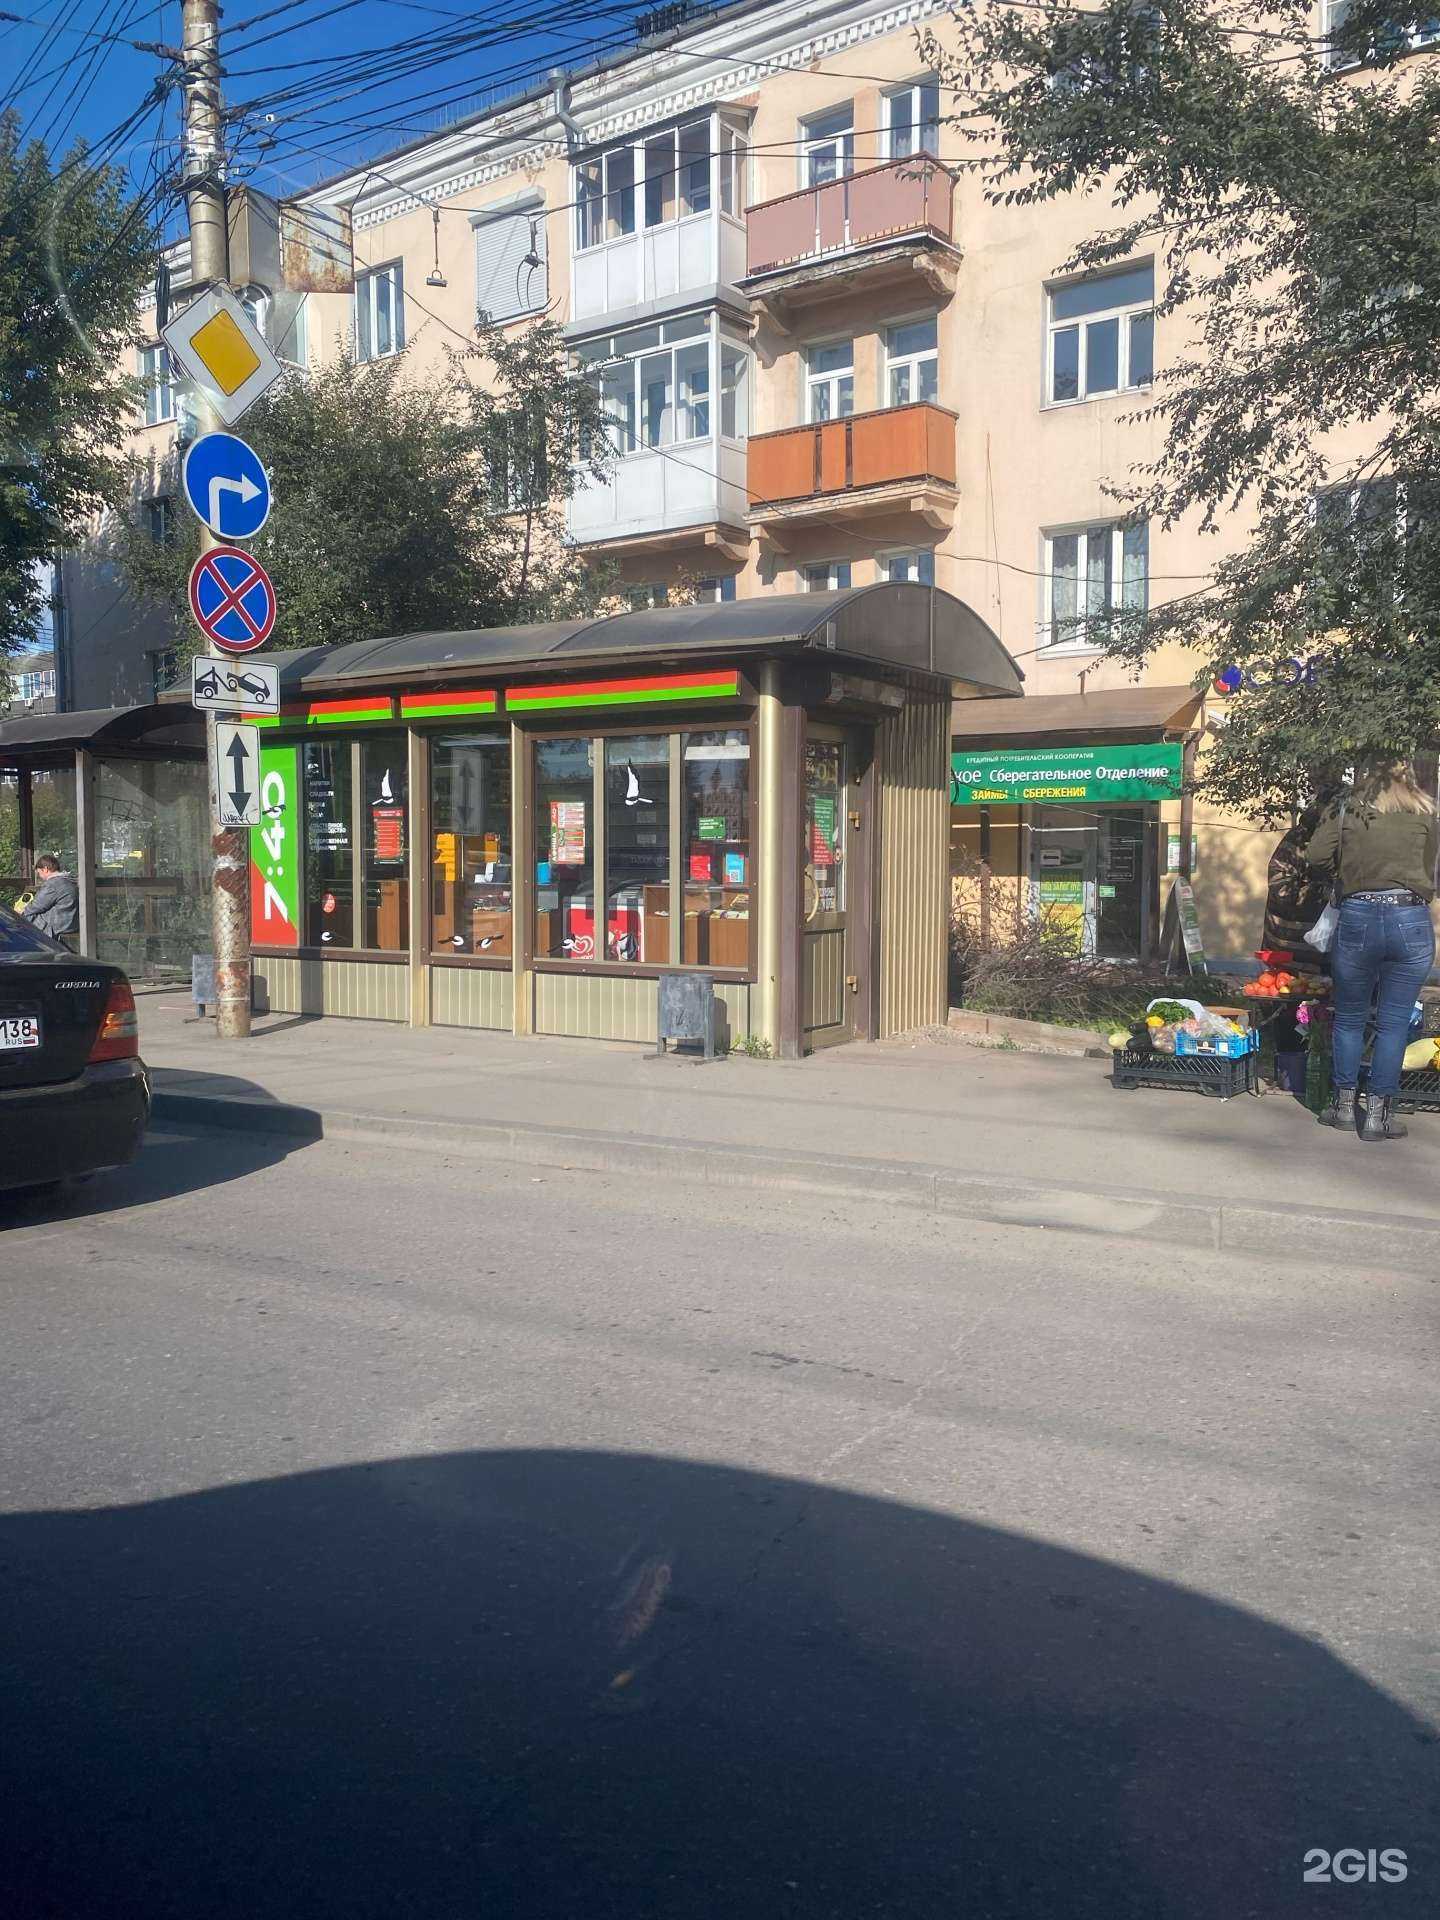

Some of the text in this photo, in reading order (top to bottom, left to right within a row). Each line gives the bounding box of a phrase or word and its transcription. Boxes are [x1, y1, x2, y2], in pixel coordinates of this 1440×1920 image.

[1000, 753, 1054, 762] ПОТРЕБИТЕЛЬСКИЙ
[1054, 752, 1094, 760] КООПЕРАТИВ
[950, 766, 1169, 784] кое Сберегательное Отделение
[971, 786, 1086, 800] ЗАЙМЫ СБЕРЕЖЕНИЯ
[6, 1037, 23, 1046] RUS
